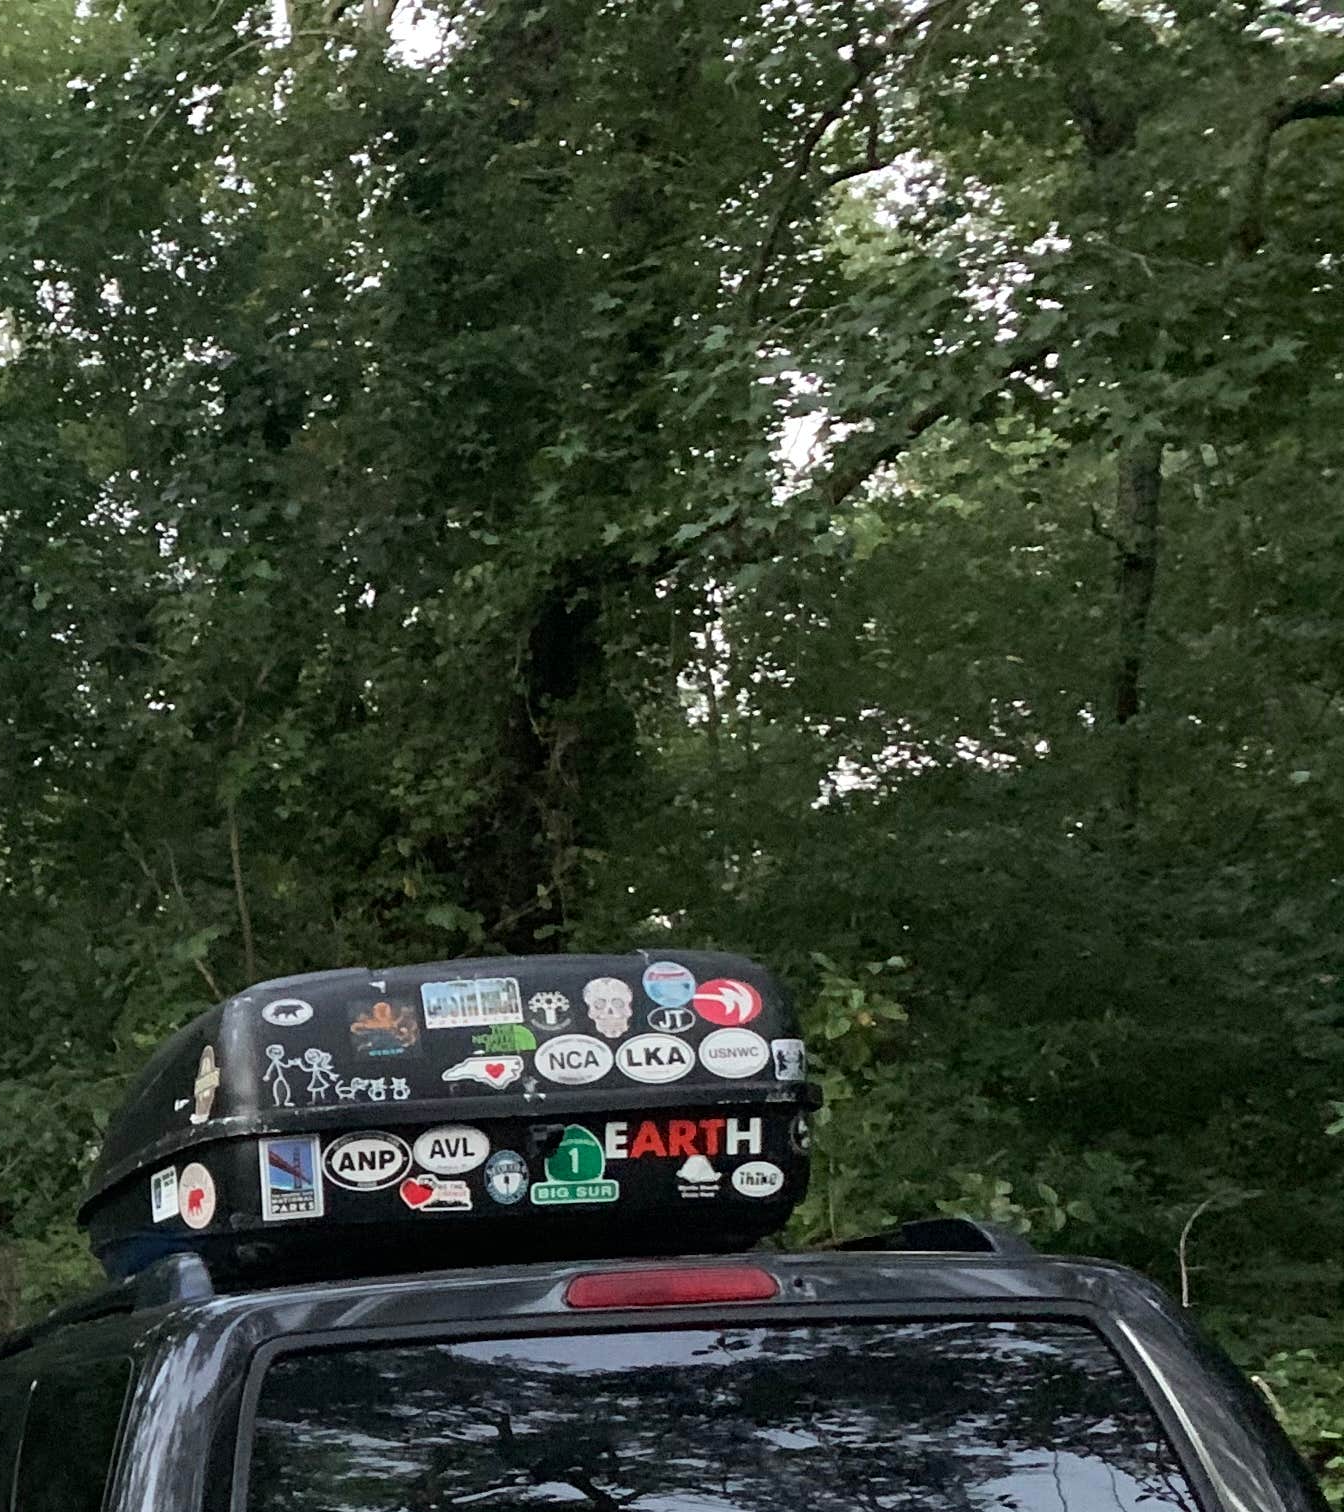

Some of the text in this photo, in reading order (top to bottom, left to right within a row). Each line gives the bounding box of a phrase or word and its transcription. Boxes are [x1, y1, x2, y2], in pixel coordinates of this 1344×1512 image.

[658, 1009, 684, 1028] JT
[548, 1049, 600, 1071] NCA
[626, 1046, 687, 1067] LKA
[708, 1046, 760, 1059] USNWC
[605, 1117, 762, 1159] EARTH
[429, 1138, 476, 1160] AVL
[338, 1150, 396, 1172] ANP
[568, 1147, 579, 1174] 1
[537, 1187, 570, 1199] BIG
[576, 1185, 612, 1197] SUR
[271, 1201, 315, 1213] PARKS
